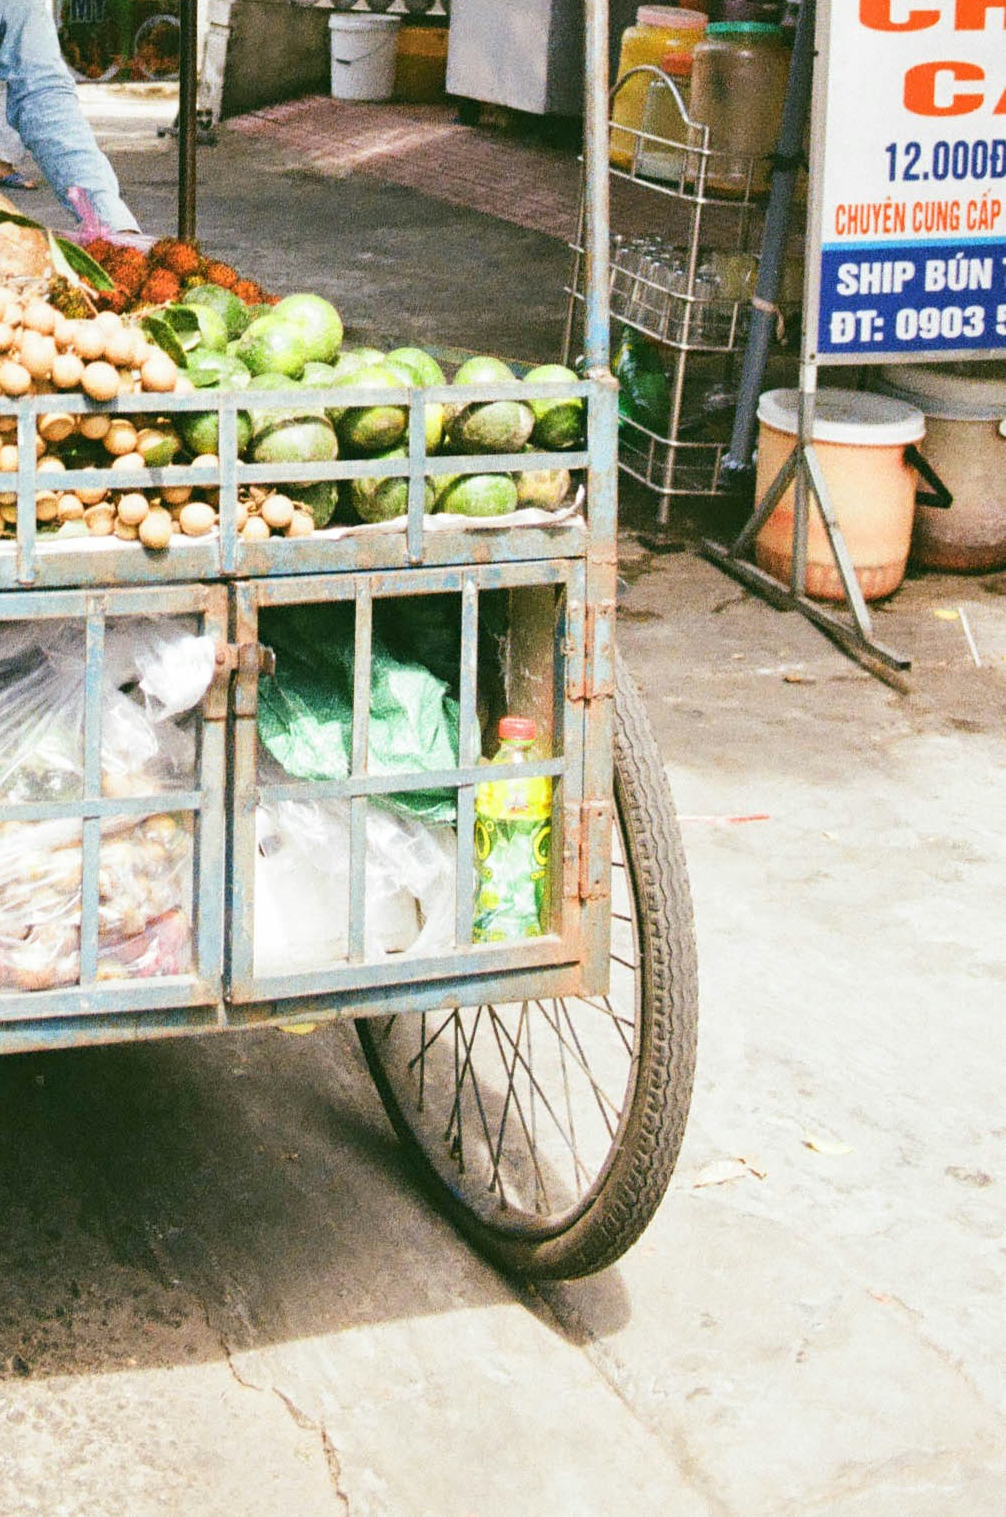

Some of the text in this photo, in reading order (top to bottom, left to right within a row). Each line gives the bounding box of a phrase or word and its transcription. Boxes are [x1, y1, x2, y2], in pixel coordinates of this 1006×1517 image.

[835, 187, 1002, 235] CHUYÊN CUNG CẤP
[836, 261, 916, 296] SHIP
[924, 251, 993, 292] BÚN
[829, 309, 885, 344] ĐT:
[895, 305, 986, 341] 0903
